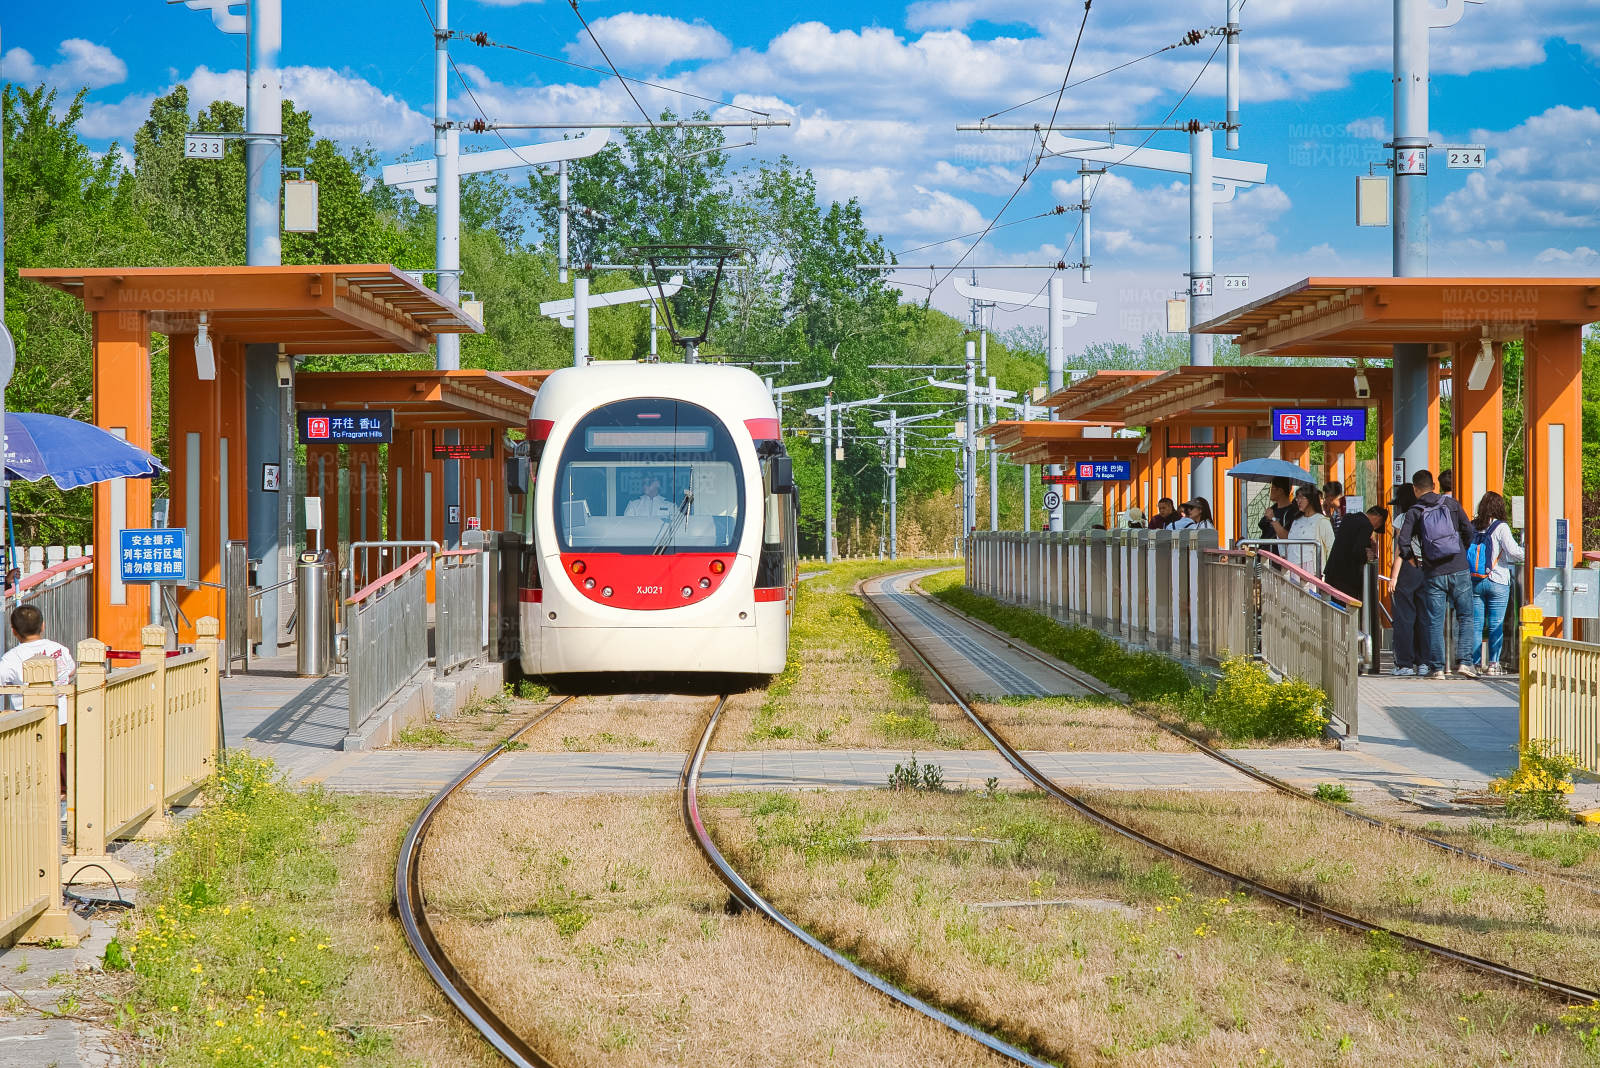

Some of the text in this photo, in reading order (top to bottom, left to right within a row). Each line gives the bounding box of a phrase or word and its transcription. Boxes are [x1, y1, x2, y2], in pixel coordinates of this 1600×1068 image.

[189, 142, 219, 153] 233
[1450, 154, 1482, 164] 234
[332, 418, 380, 429] 开往 香山
[1306, 415, 1354, 426] 开往 巴沟
[1316, 429, 1338, 437] Bagou
[1048, 496, 1056, 505] 15
[132, 535, 174, 545] 安全提示
[124, 548, 182, 560] 列车运行区域
[124, 562, 182, 574] 请勿停留拍照
